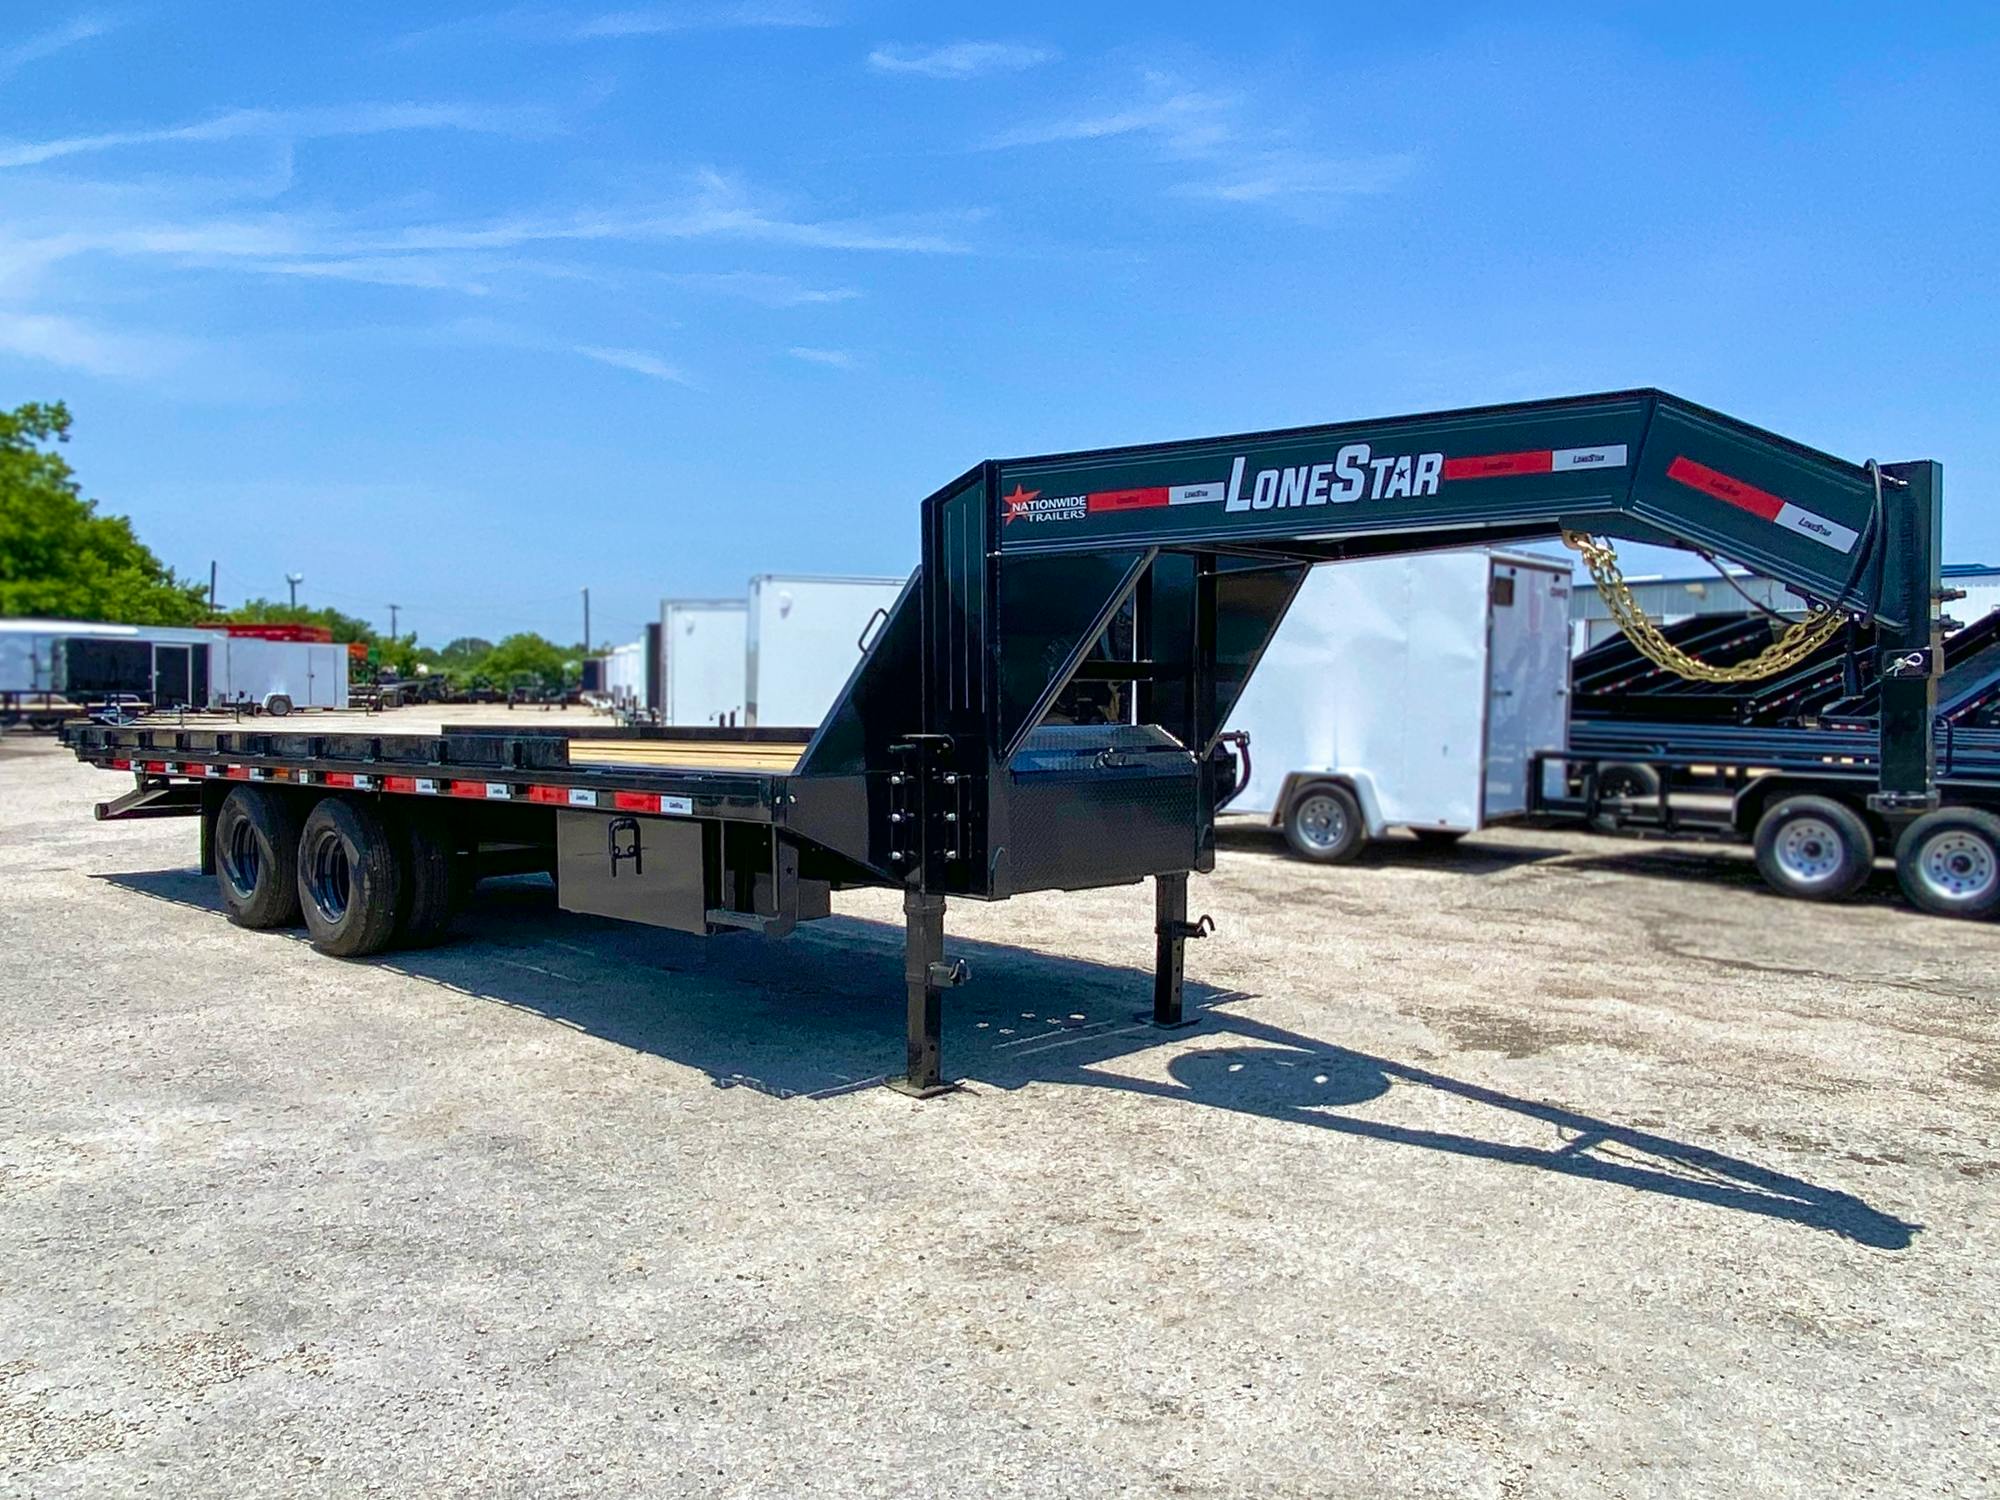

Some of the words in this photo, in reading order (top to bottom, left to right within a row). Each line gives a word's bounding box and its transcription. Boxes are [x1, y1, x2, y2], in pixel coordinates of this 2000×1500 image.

[1225, 444, 1444, 512] LONESTAR
[1012, 495, 1087, 512] NATIONWIDE
[1028, 509, 1086, 522] TRAILERS
